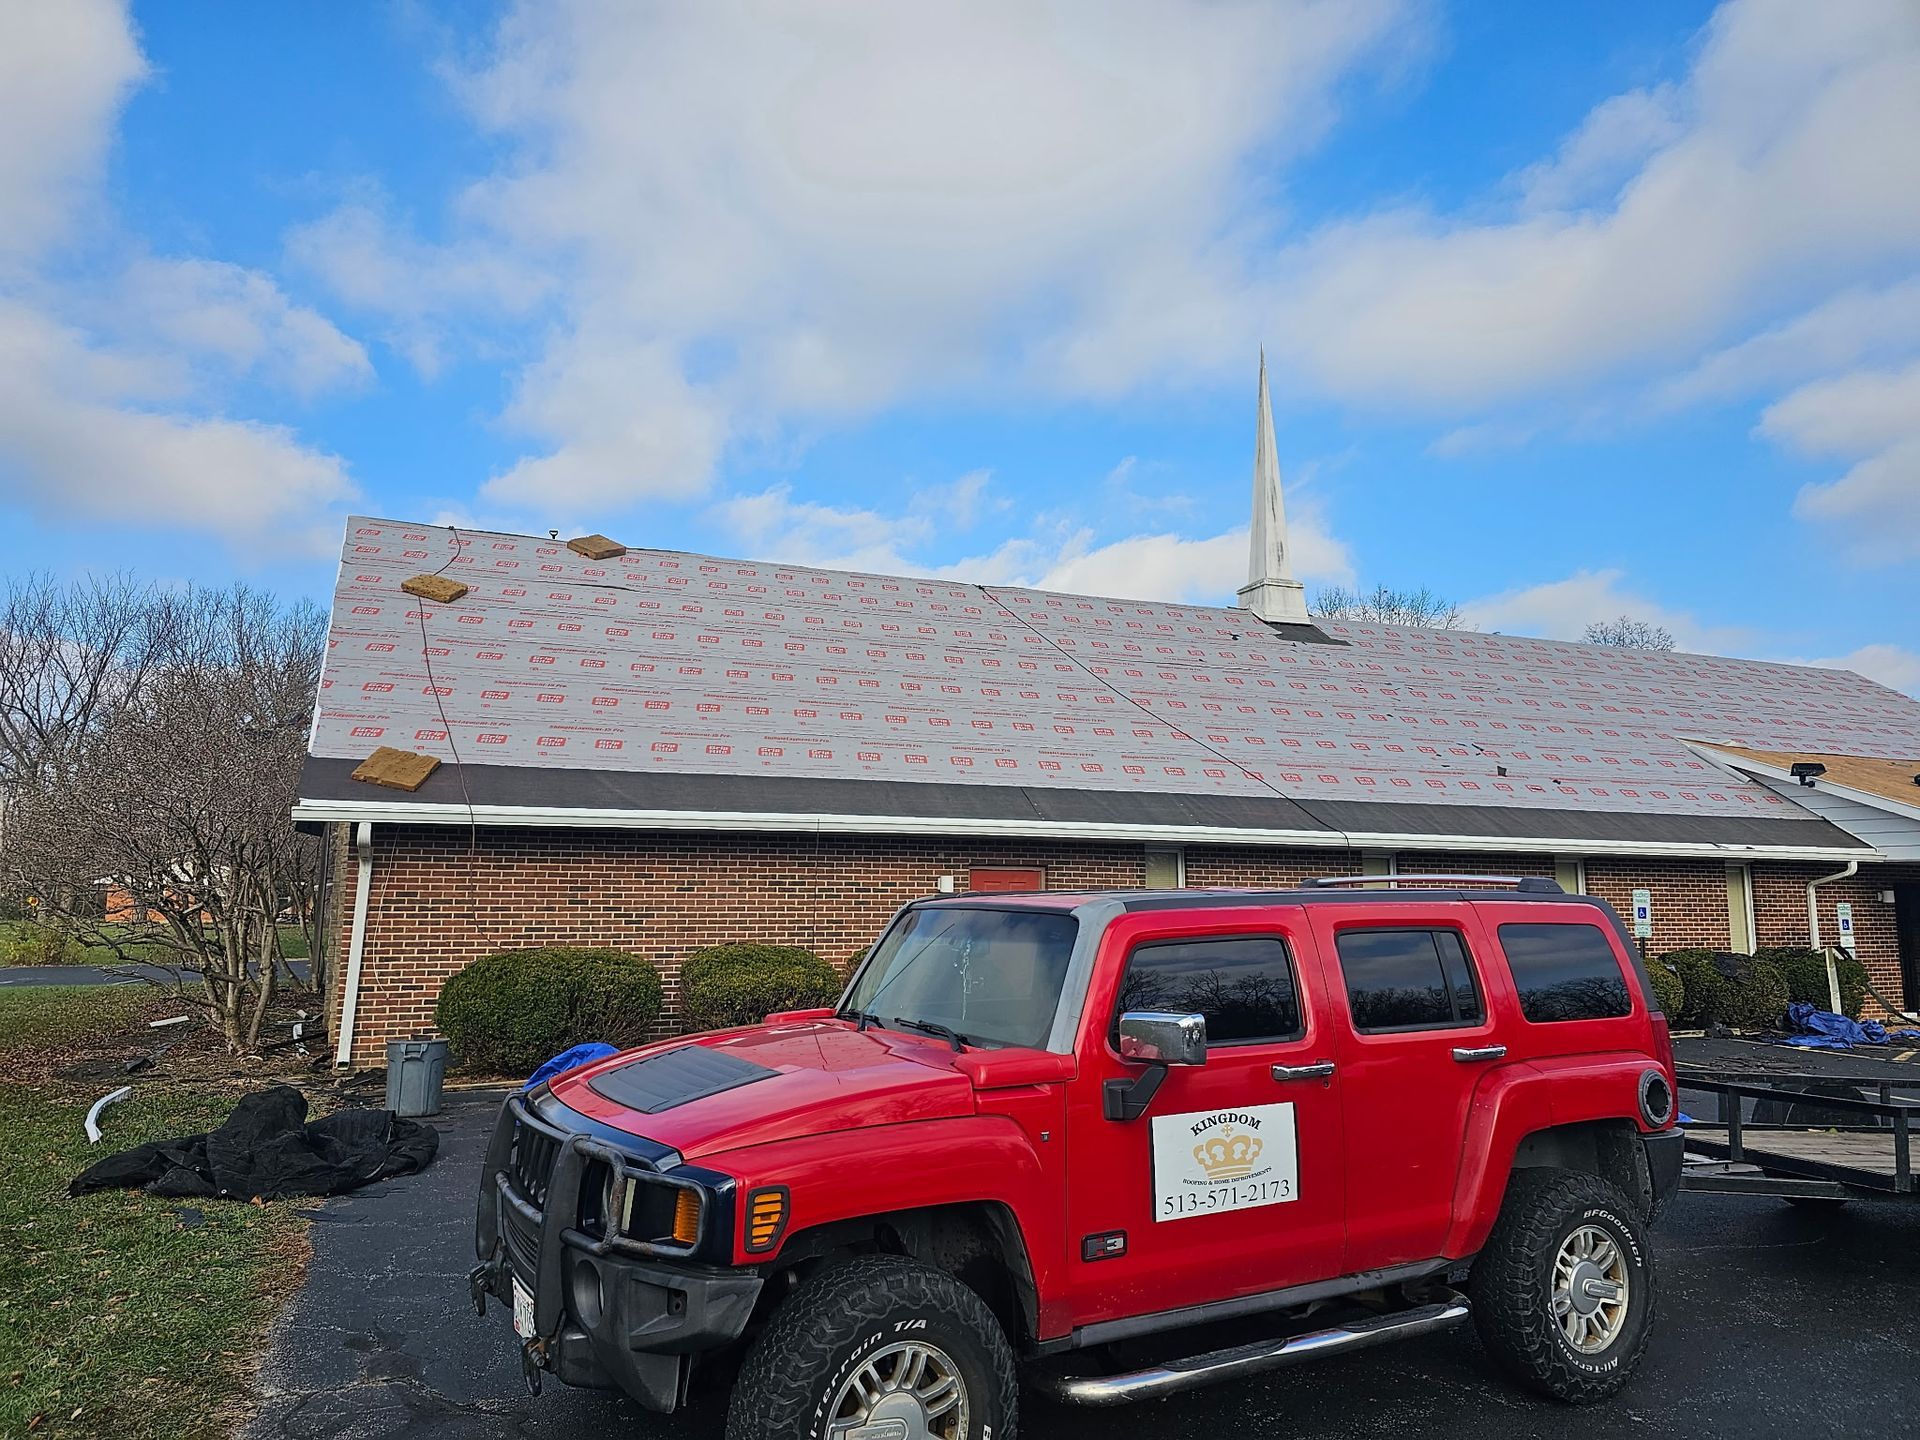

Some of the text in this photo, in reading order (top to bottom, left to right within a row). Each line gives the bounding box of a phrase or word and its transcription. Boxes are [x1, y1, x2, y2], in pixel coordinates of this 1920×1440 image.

[1190, 1112, 1262, 1136] KINGDOM
[1182, 1178, 1208, 1186] ROOFING
[1231, 1165, 1272, 1183] IMPROVEMENTS
[1164, 1179, 1290, 1215] 513-571-2173
[1583, 1208, 1642, 1267] BFGoodrich
[1557, 1338, 1619, 1373] All-Terrain
[808, 1319, 928, 1440] l-Terrain T/A
